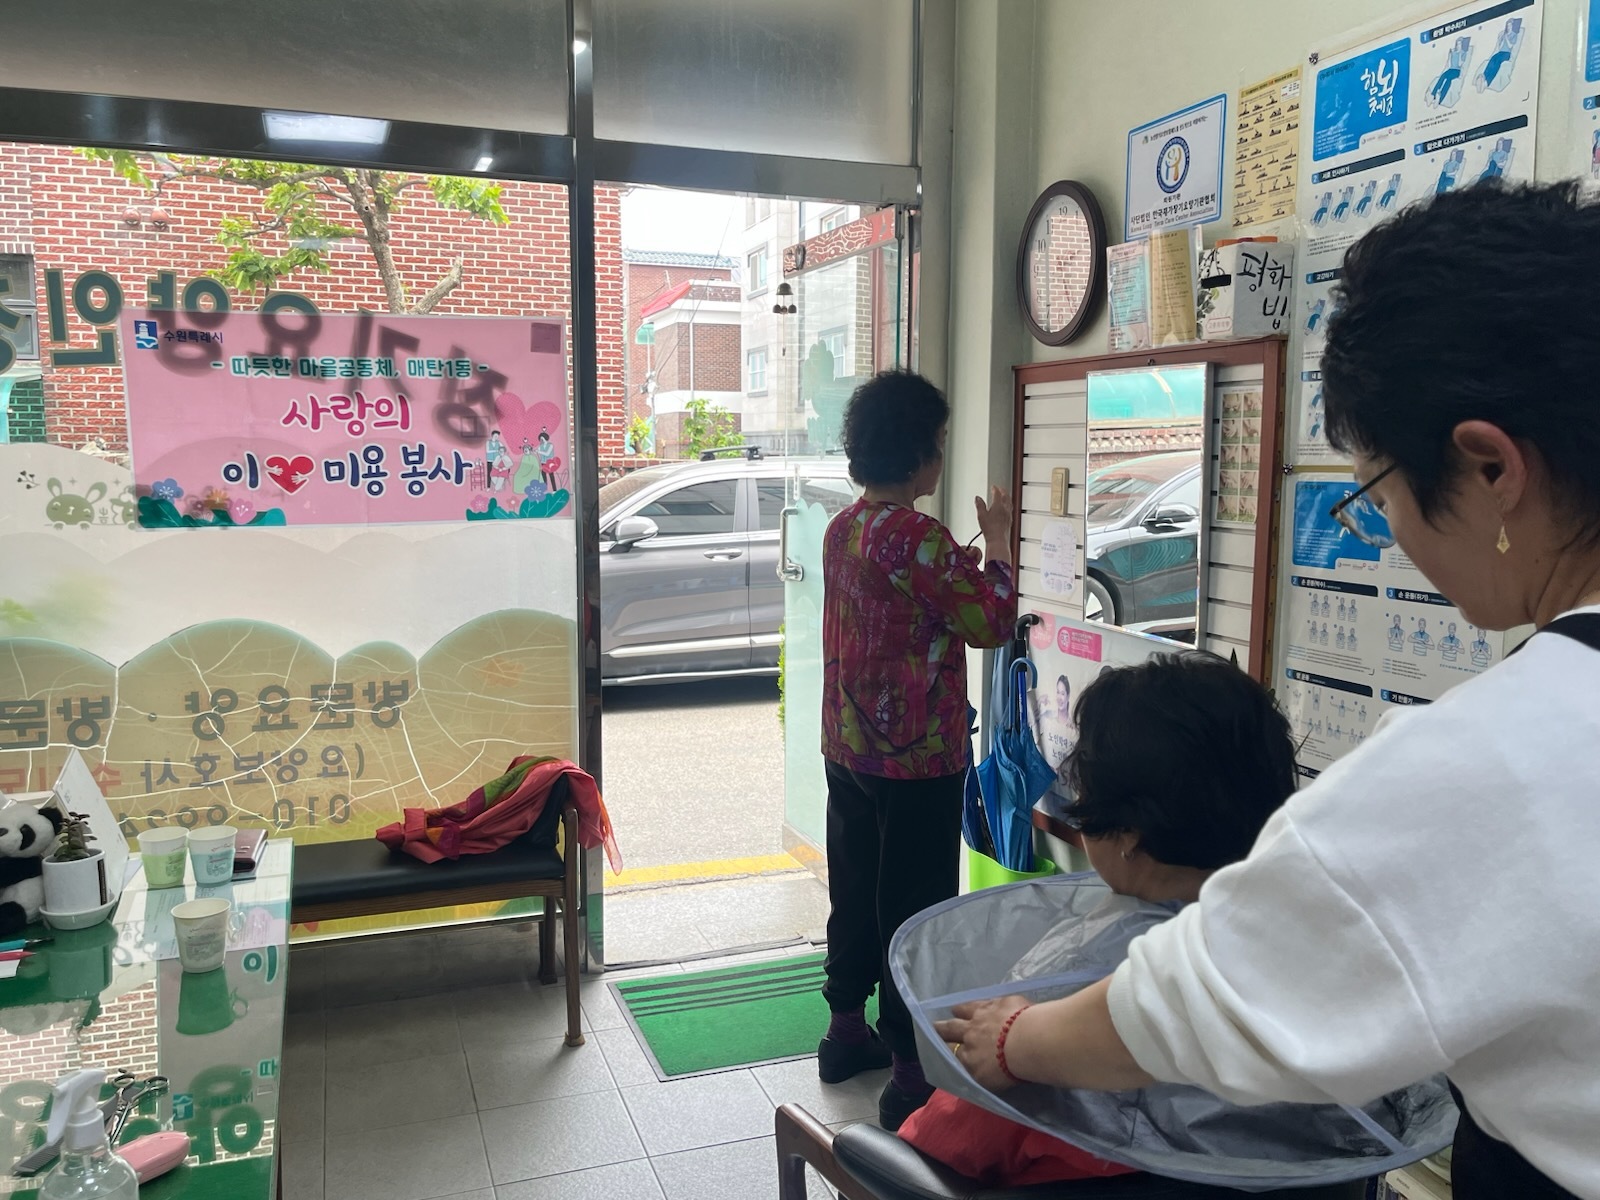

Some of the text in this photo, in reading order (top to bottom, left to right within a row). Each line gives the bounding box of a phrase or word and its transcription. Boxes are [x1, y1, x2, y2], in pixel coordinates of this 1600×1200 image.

[1585, 99, 1593, 109] 2
[1131, 212, 1151, 226] 사단법인
[1236, 251, 1293, 292] 평화
[163, 329, 223, 344] 수원특례시
[231, 356, 292, 377] 따듯한
[300, 356, 399, 378] 마을공동체,
[408, 359, 472, 378] 매탄1동
[282, 391, 410, 437] 사랑의
[222, 443, 473, 497] 이 미용 봉사
[1388, 589, 1394, 598] 3
